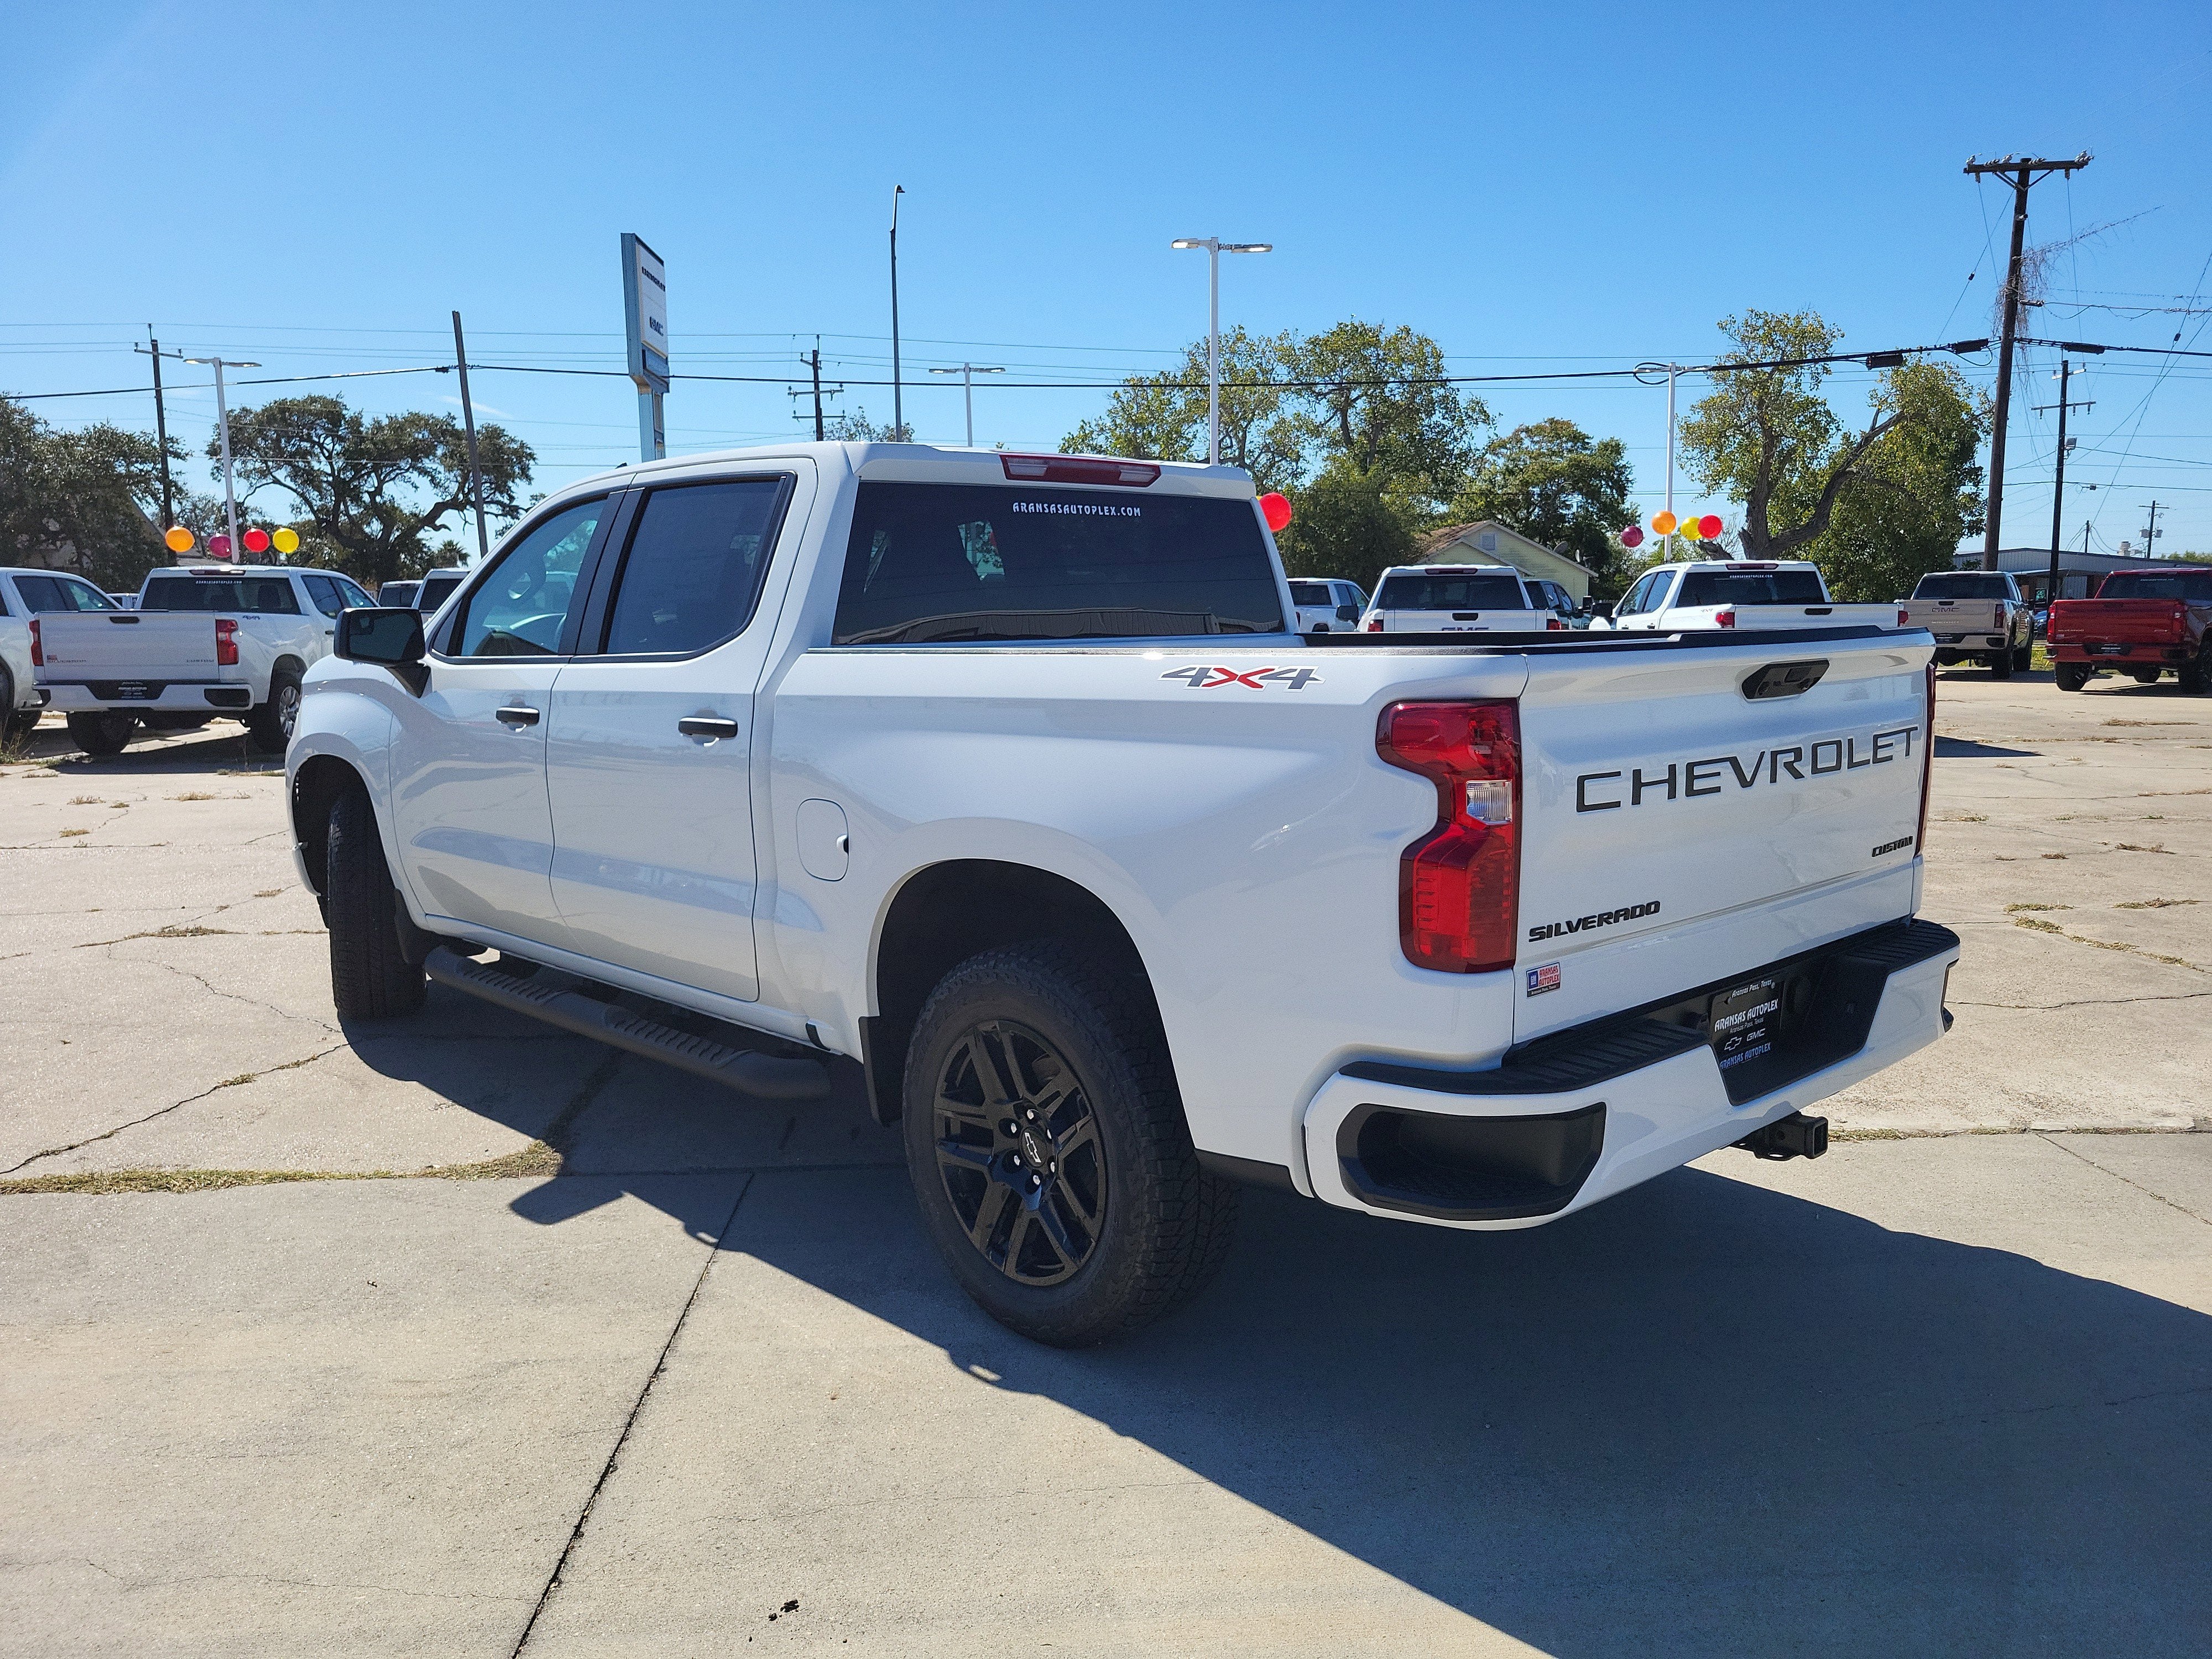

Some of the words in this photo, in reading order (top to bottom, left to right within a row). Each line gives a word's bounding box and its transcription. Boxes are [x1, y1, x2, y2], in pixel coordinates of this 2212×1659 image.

[1013, 502, 1141, 517] ARANSASAUTOPLEX.COM
[1576, 726, 1918, 812] CHEVROLET
[1528, 900, 1661, 942] SILVERADO
[1539, 966, 1558, 978] ARANSAS
[1539, 974, 1559, 987] AUTOPLEX
[1731, 988, 1748, 998] Aransas
[1749, 984, 1759, 992] Pass,
[1761, 979, 1772, 988] Texas
[1714, 1010, 1746, 1032] ARANSAS
[1747, 999, 1778, 1021] AUTOPLEX
[1730, 1024, 1744, 1034] Aransas
[1746, 1028, 1766, 1041] GMC
[1720, 1052, 1743, 1069] ARANSAS
[1745, 1042, 1771, 1060] AUTOPLEX
